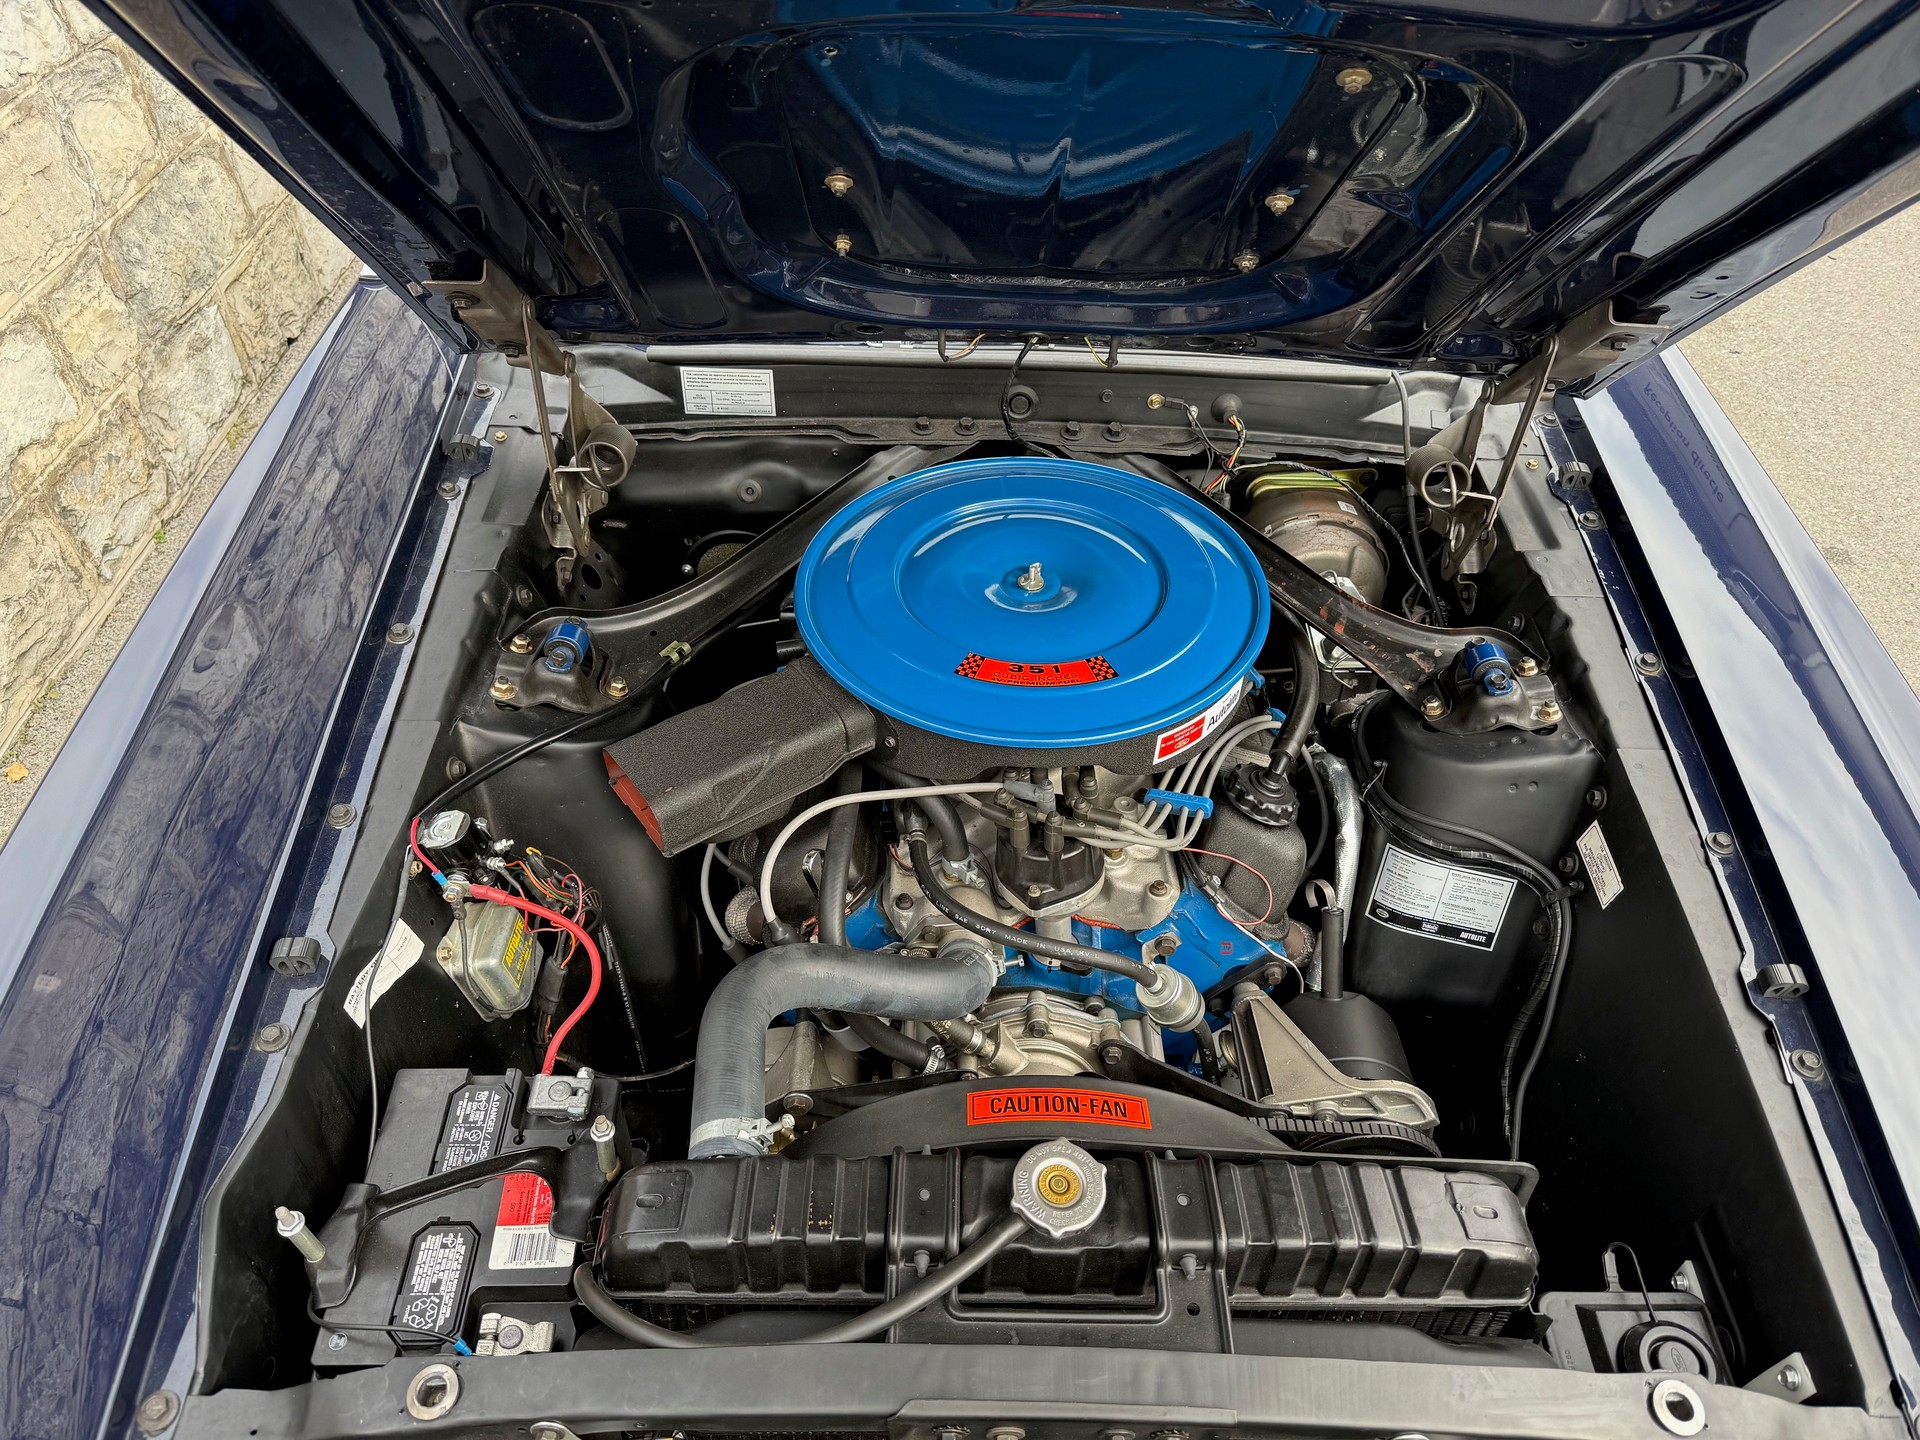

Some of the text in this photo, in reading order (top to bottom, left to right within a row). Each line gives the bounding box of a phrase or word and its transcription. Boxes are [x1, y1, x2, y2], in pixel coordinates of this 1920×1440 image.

[993, 671, 1079, 681] CUBIC INCHES
[1008, 664, 1061, 674] 351
[935, 900, 950, 914] LINE
[954, 913, 969, 924] SAE
[1004, 933, 1028, 945] MADE
[505, 918, 524, 967] AUTOLITE
[1459, 930, 1486, 943] AUTOLITE
[485, 1100, 499, 1133] DANGER
[990, 1095, 1128, 1118] CAUTION-FAN
[1026, 1154, 1037, 1164] DO
[1036, 1146, 1050, 1157] NOT
[1018, 1170, 1047, 1220] WARNING
